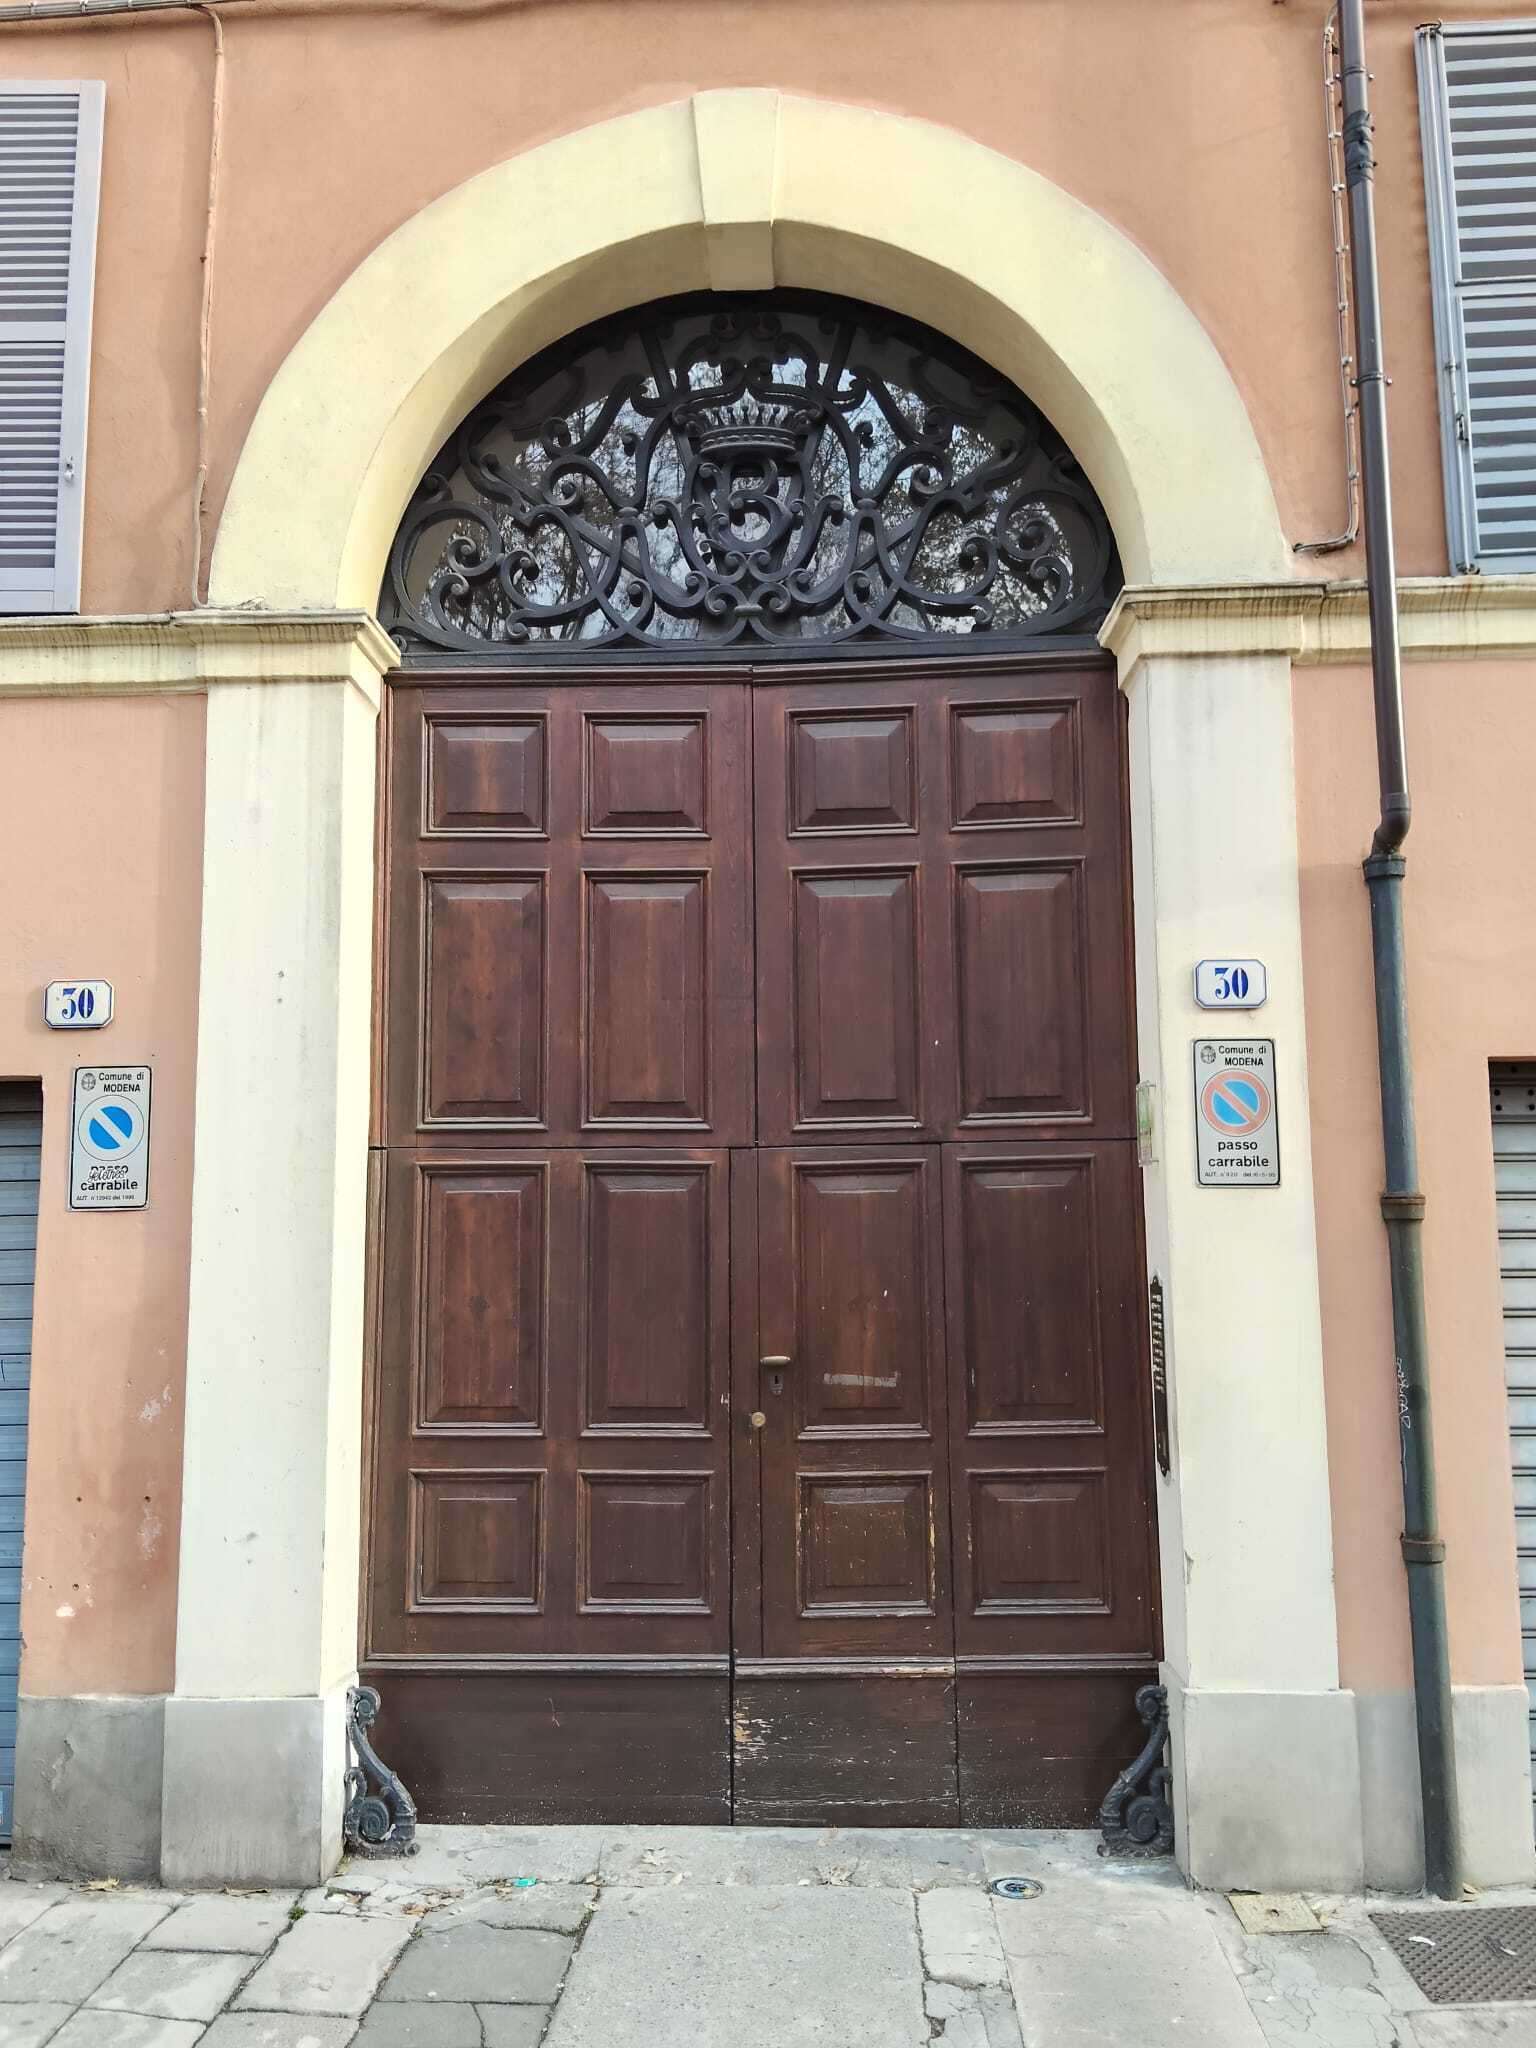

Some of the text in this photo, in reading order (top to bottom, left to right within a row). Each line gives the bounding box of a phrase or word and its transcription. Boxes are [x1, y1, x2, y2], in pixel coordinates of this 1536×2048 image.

[1214, 967, 1249, 1000] 30
[61, 987, 95, 1020] 30
[1218, 1045, 1267, 1055] Comune di
[1224, 1057, 1264, 1067] MODENA
[98, 1071, 145, 1081] Comune di
[103, 1083, 141, 1093] MODENA
[1217, 1141, 1258, 1152] passo
[1208, 1155, 1269, 1167] carrabile
[80, 1179, 138, 1191] carrabile
